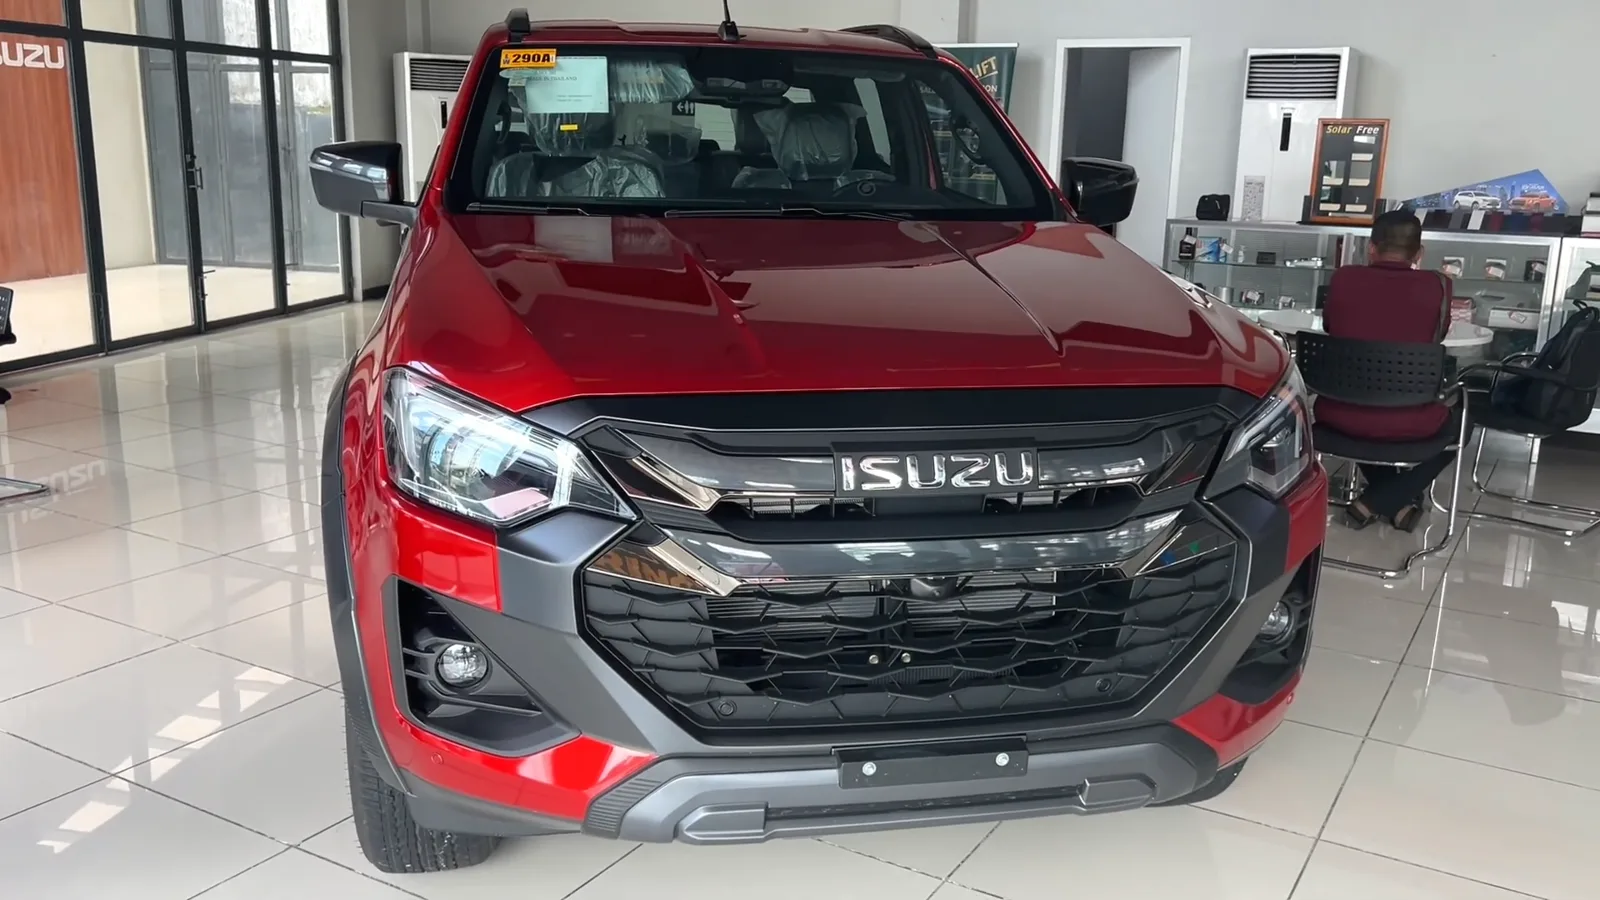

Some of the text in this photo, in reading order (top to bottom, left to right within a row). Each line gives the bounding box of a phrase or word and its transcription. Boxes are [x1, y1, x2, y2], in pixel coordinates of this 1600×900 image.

[0, 41, 65, 69] UZU
[512, 53, 550, 63] 290A
[1326, 125, 1380, 134] Solar Free
[841, 451, 1034, 491] ISUZU
